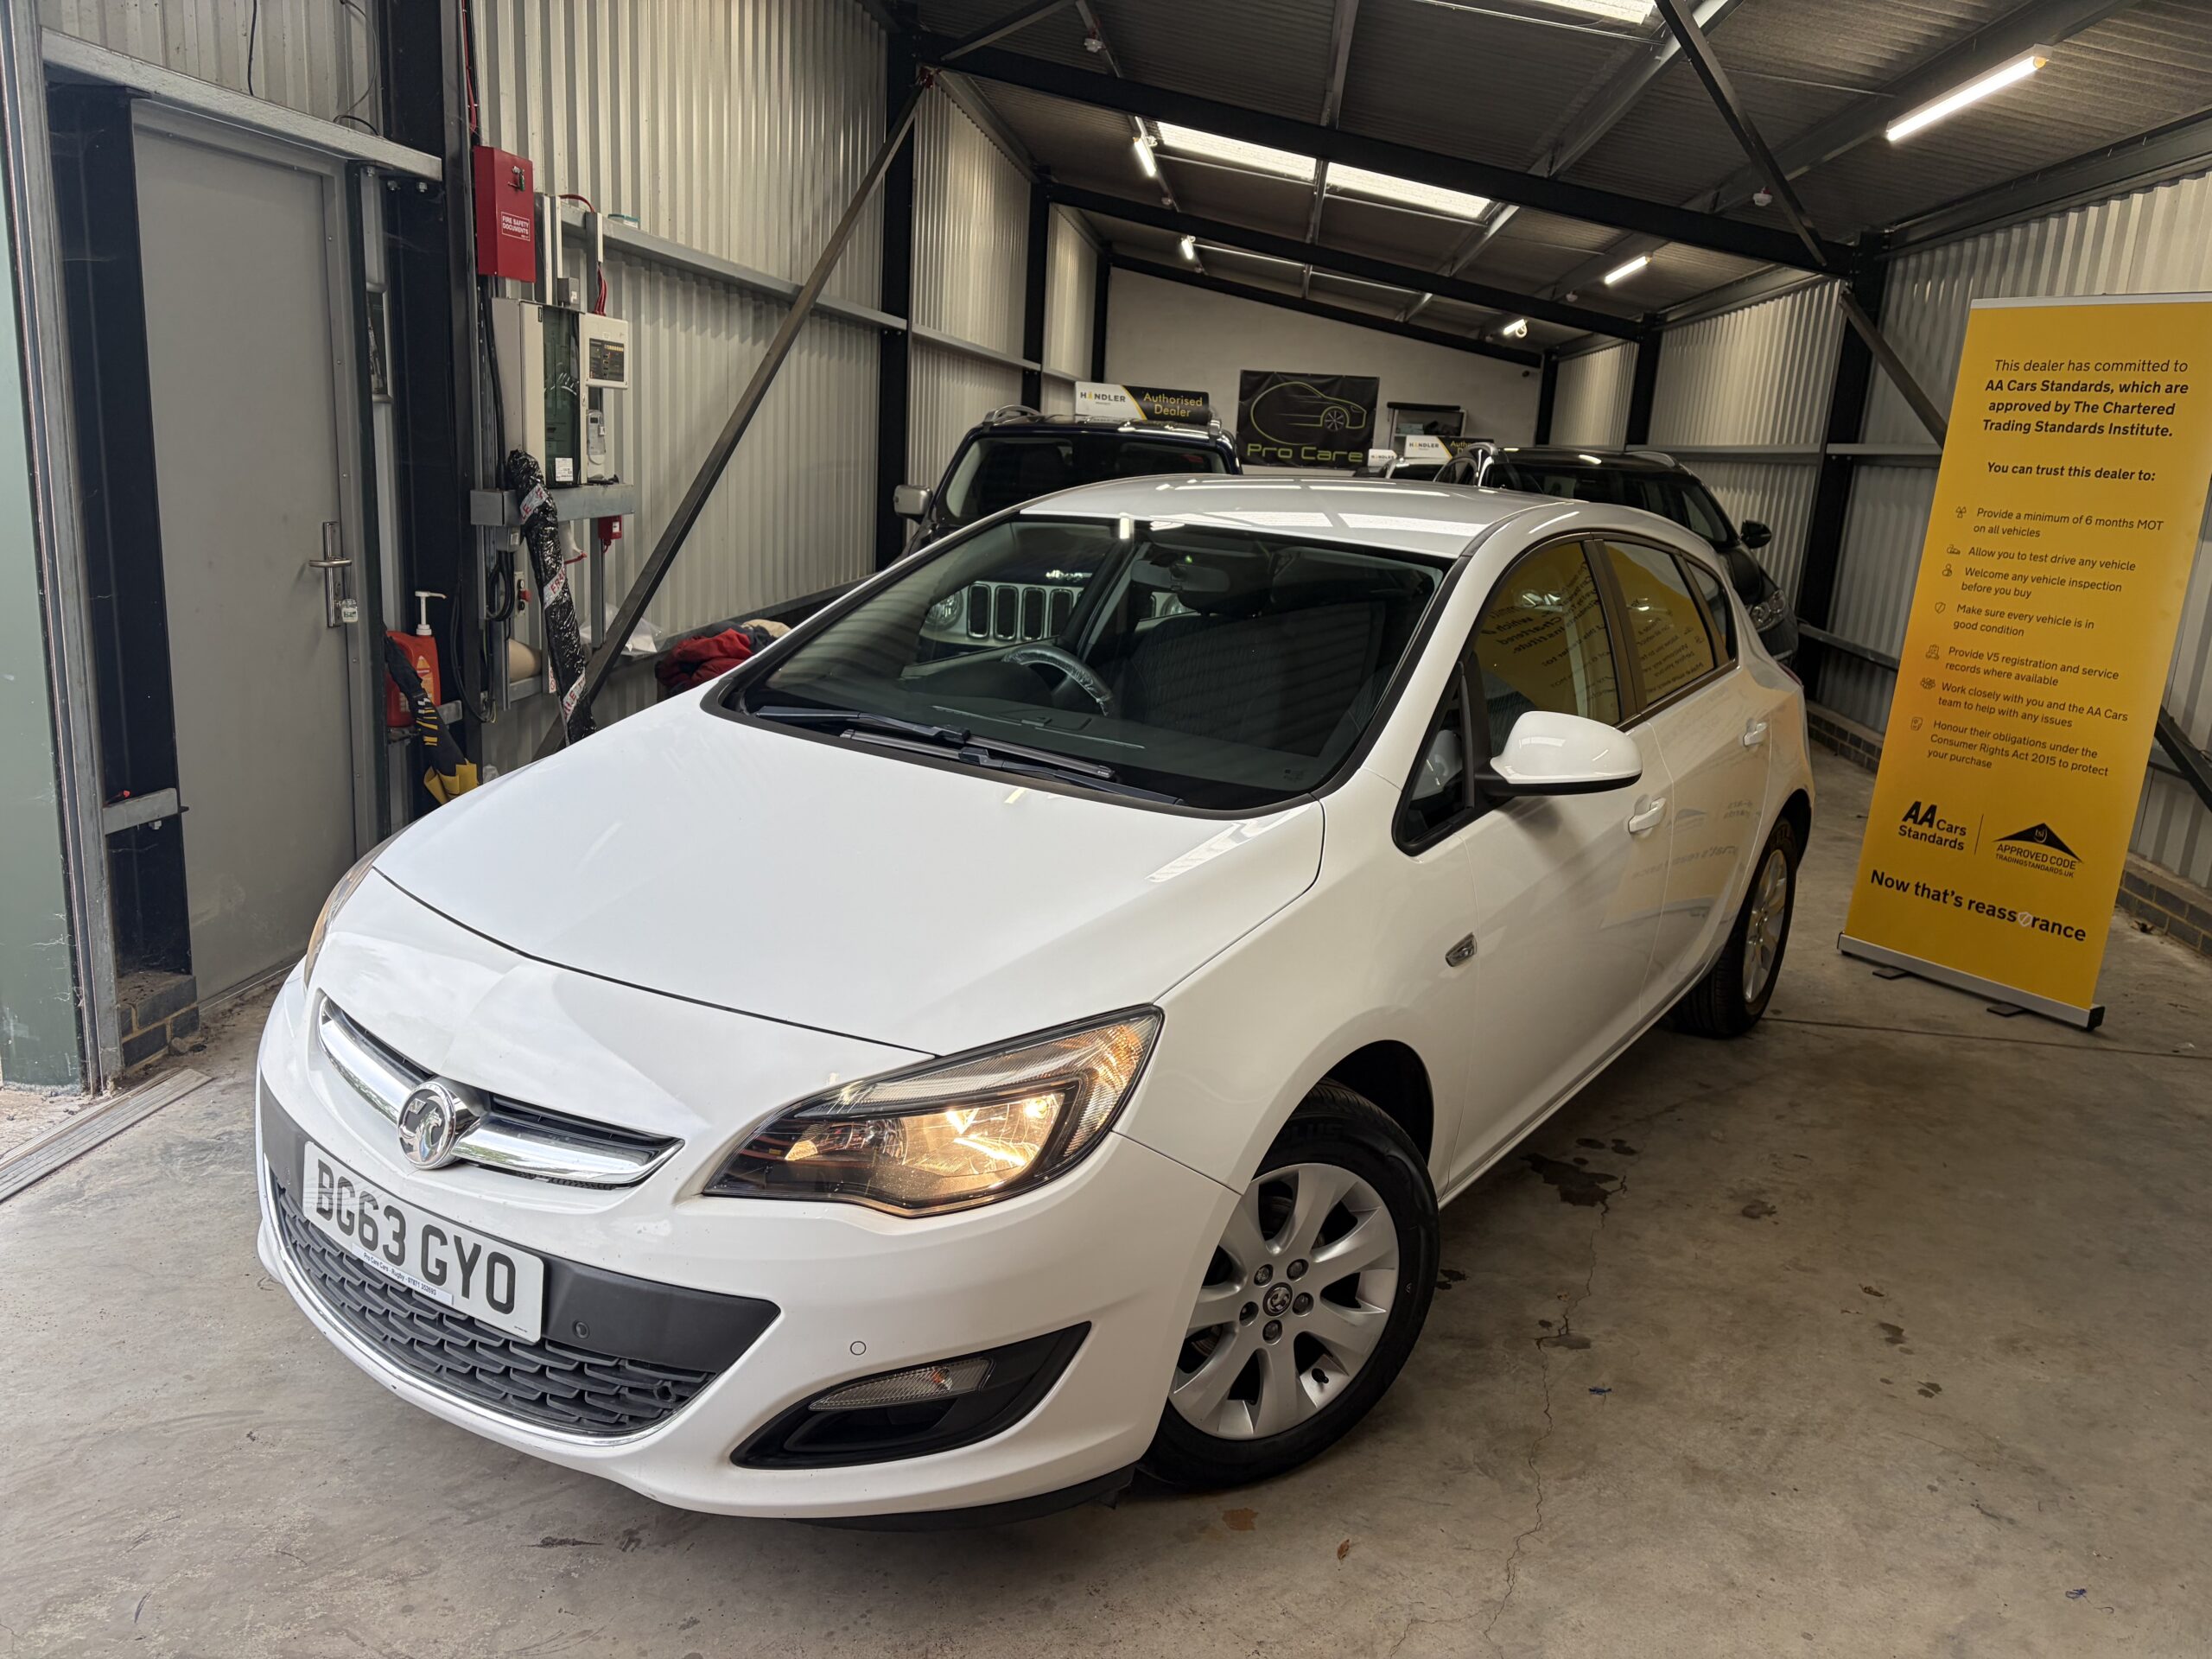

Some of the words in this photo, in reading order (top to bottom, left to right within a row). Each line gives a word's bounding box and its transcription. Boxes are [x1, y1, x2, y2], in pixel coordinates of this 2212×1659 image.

[502, 215, 512, 224] FIRE
[512, 219, 529, 229] SAFETY
[502, 222, 529, 235] DOCUMENTS
[1995, 359, 2020, 372] This
[2023, 359, 2065, 372] dealer
[2067, 359, 2091, 372] has
[2094, 359, 2171, 372] committed
[2173, 359, 2189, 372] to
[1985, 379, 2004, 391] AA
[2006, 379, 2037, 392] Cars
[2040, 379, 2114, 395] Standards,
[2119, 380, 2162, 394] which
[2164, 384, 2189, 394] are
[1143, 392, 1203, 407] Authorised
[1154, 404, 1192, 417] Dealer
[1988, 400, 2052, 414] approved
[2054, 400, 2071, 416] by
[2074, 400, 2100, 414] The
[2102, 401, 2176, 416] Chartered
[1983, 419, 2031, 435] Trading
[2034, 420, 2105, 435] Standards
[2108, 423, 2173, 437] Institute.
[1247, 442, 1293, 461] Pro
[1300, 445, 1364, 463] Care
[1987, 461, 2009, 474] You
[2011, 465, 2033, 474] can
[2036, 464, 2065, 476] trust
[2068, 466, 2091, 478] this
[2094, 467, 2136, 480] dealer
[2138, 469, 2156, 481] to:
[1976, 507, 2014, 519] Provide
[2023, 512, 2069, 524] minimum
[2072, 515, 2084, 524] of
[2085, 515, 2093, 525] 6
[2094, 518, 2134, 529] months
[2137, 519, 2164, 531] MOT
[1987, 524, 2000, 535] all
[2001, 526, 2041, 537] vehicles
[1968, 547, 1996, 557] Allow
[1997, 551, 2015, 560] you
[2017, 551, 2027, 561] to
[2029, 552, 2049, 563] test
[2050, 554, 2076, 566] drive
[2078, 558, 2097, 569] any
[2099, 559, 2136, 571] vehicle
[1961, 582, 1993, 594] before
[1993, 587, 2012, 596] you
[2013, 587, 2032, 600] buy
[1965, 567, 2010, 581] Welcome
[2011, 574, 2029, 584] any
[2031, 575, 2066, 587] vehicle
[2068, 577, 2122, 592] inspection
[1956, 604, 1982, 615] Make
[1984, 609, 2005, 619] sure
[2007, 612, 2034, 624] every
[2036, 614, 2072, 626] vehicle
[2074, 618, 2082, 628] is
[2085, 620, 2094, 629] in
[1953, 621, 1979, 631] good
[1980, 624, 2024, 637] condition
[1945, 663, 1981, 675] records
[1983, 667, 2012, 679] where
[2014, 673, 2059, 686] available
[1948, 646, 1985, 660] Provide
[1986, 652, 1999, 662] V5
[2001, 656, 2058, 671] registration
[2060, 664, 2080, 674] and
[2082, 667, 2119, 680] service
[1938, 696, 1961, 709] team
[1963, 700, 1974, 710] to
[1975, 702, 1996, 715] help
[1998, 708, 2018, 718] with
[2020, 712, 2039, 723] any
[2041, 714, 2073, 728] issues
[1942, 682, 1967, 695] Work
[1968, 687, 2001, 702] closely
[2003, 693, 2024, 704] with
[2025, 698, 2044, 708] you
[2046, 701, 2066, 711] and
[2068, 703, 2085, 715] the
[2086, 706, 2101, 717] AA
[2104, 709, 2128, 721] Cars
[1933, 720, 1968, 734] Honour
[1969, 727, 1992, 739] their
[1993, 732, 2047, 749] obligations
[2050, 743, 2080, 755] under
[2081, 747, 2098, 759] the
[1927, 749, 1948, 760] your
[1949, 753, 1993, 769] purchase
[1930, 734, 1978, 751] Consumer
[1979, 742, 2010, 758] Rights
[2012, 749, 2029, 761] Act
[2031, 753, 2056, 766] 2015
[2058, 758, 2069, 768] to
[2070, 762, 2108, 777] protect
[1901, 800, 1938, 830] AA
[1936, 818, 1967, 836] Cars
[1897, 824, 1965, 851] Standards
[1996, 843, 2049, 863] APPROVED
[2050, 855, 2076, 871] CODE
[1871, 869, 1911, 893] Now
[1967, 899, 2086, 942] reassrance
[317, 1159, 407, 1267] BG63
[421, 1224, 516, 1315] GYO
